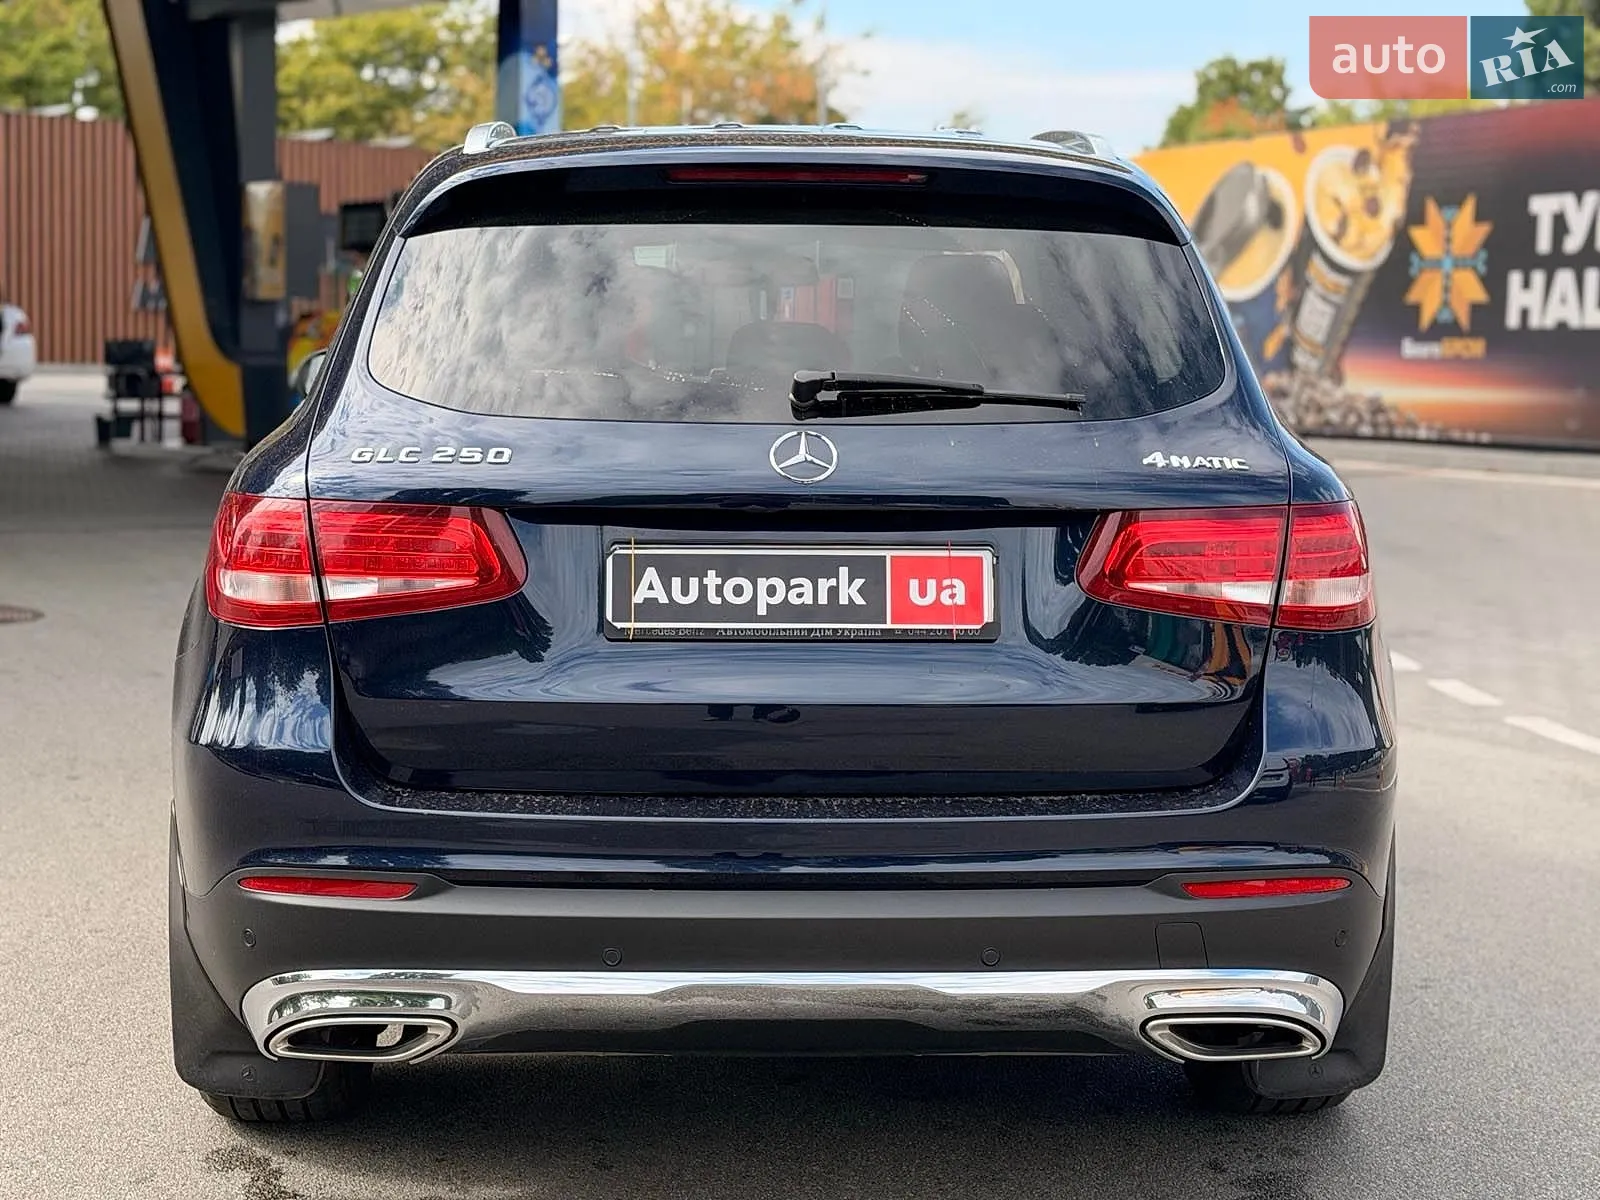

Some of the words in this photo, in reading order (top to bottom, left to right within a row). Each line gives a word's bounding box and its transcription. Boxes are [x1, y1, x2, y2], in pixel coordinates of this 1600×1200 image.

[1527, 189, 1600, 256] ТУ
[350, 447, 422, 464] GLC
[431, 446, 513, 465] 250
[1142, 451, 1250, 470] 4MATIC
[632, 567, 867, 616] Autopark
[908, 577, 967, 607] ua
